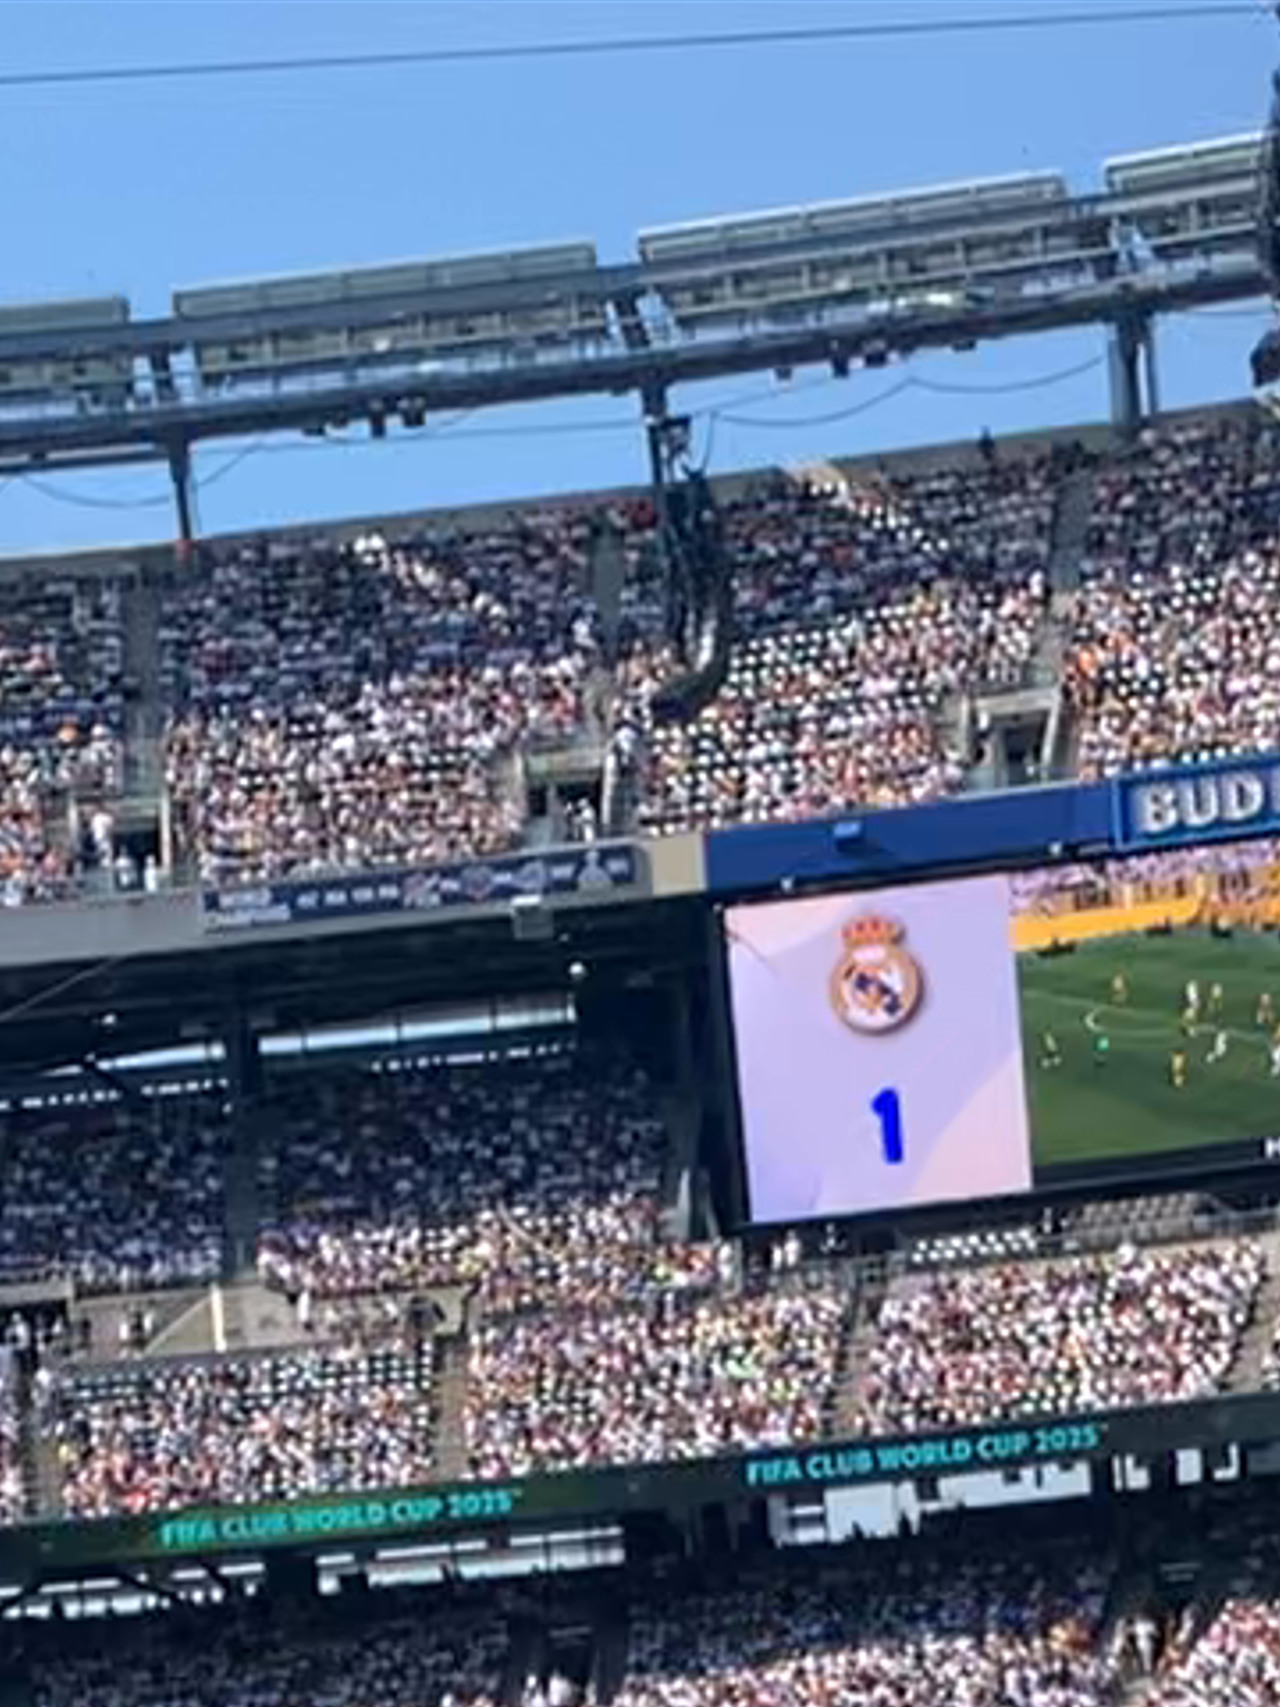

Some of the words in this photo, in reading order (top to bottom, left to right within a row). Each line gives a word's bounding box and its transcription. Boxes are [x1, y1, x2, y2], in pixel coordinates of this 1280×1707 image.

[1134, 771, 1264, 833] BUD
[871, 1088, 902, 1164] 1
[746, 1458, 803, 1484] FIFA
[806, 1450, 875, 1479] CLUB
[877, 1439, 972, 1469] WORLD
[976, 1432, 1031, 1460] CUP
[1035, 1426, 1098, 1451] 2025
[160, 1521, 216, 1548] FIFA
[222, 1514, 287, 1540] CLUB
[294, 1502, 387, 1533] WORLD
[391, 1496, 443, 1523] CUP
